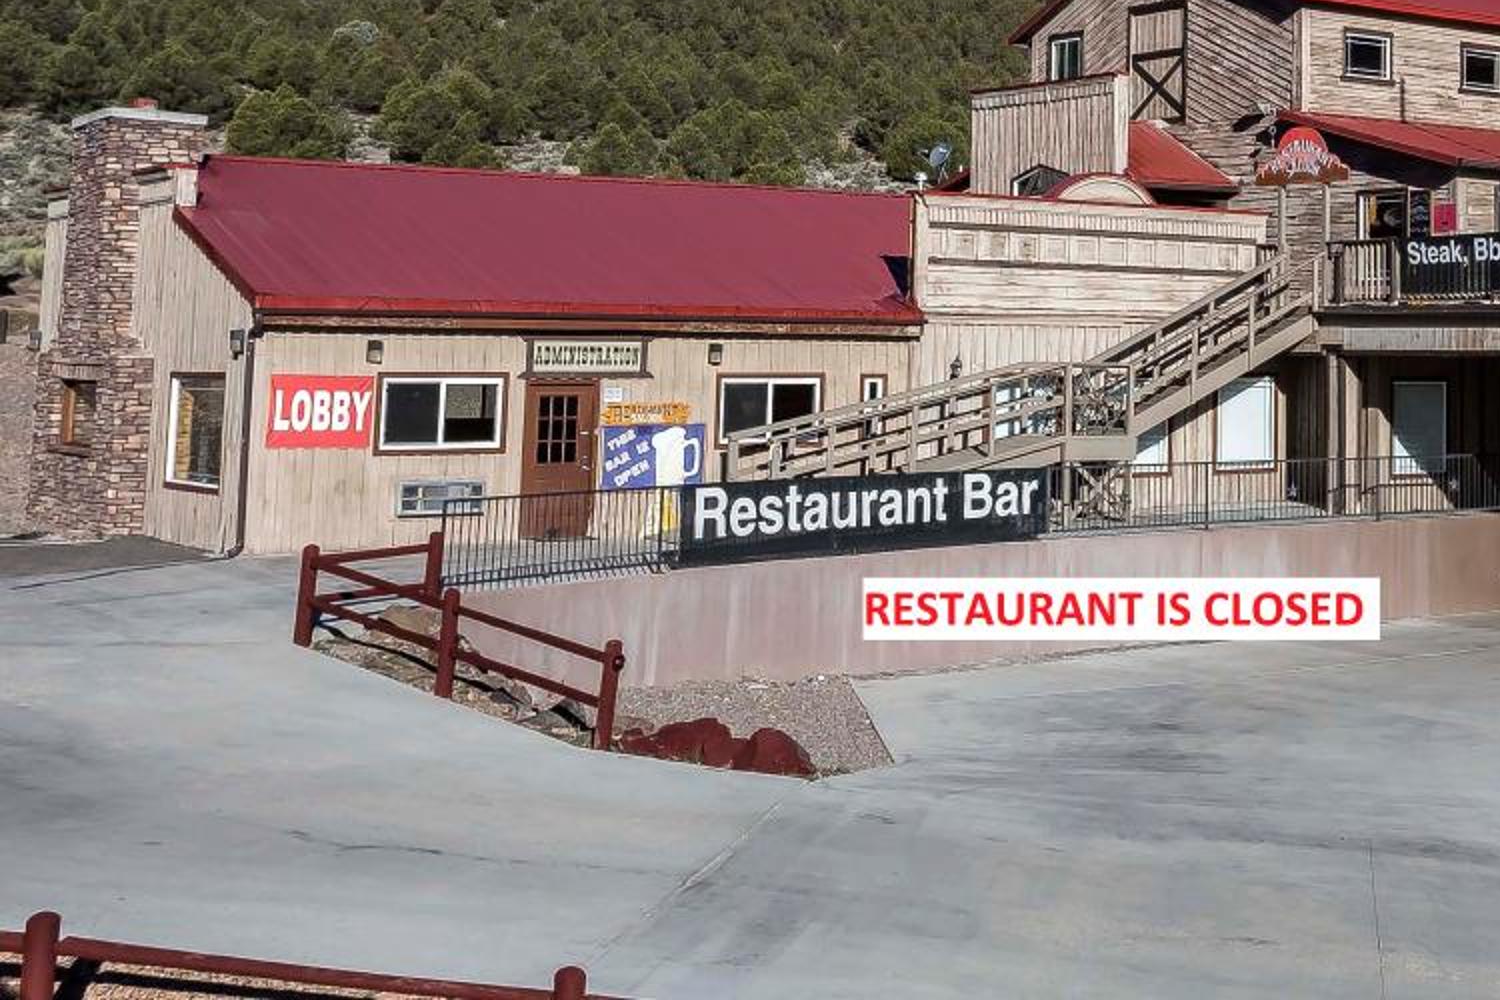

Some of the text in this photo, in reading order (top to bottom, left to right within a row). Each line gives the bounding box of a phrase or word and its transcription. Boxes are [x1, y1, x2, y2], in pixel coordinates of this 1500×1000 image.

[1406, 241, 1469, 267] Steak,
[535, 346, 640, 366] ADMINISTRATION
[273, 389, 373, 432] LOBBY
[694, 473, 1040, 539] Restaurant Bar
